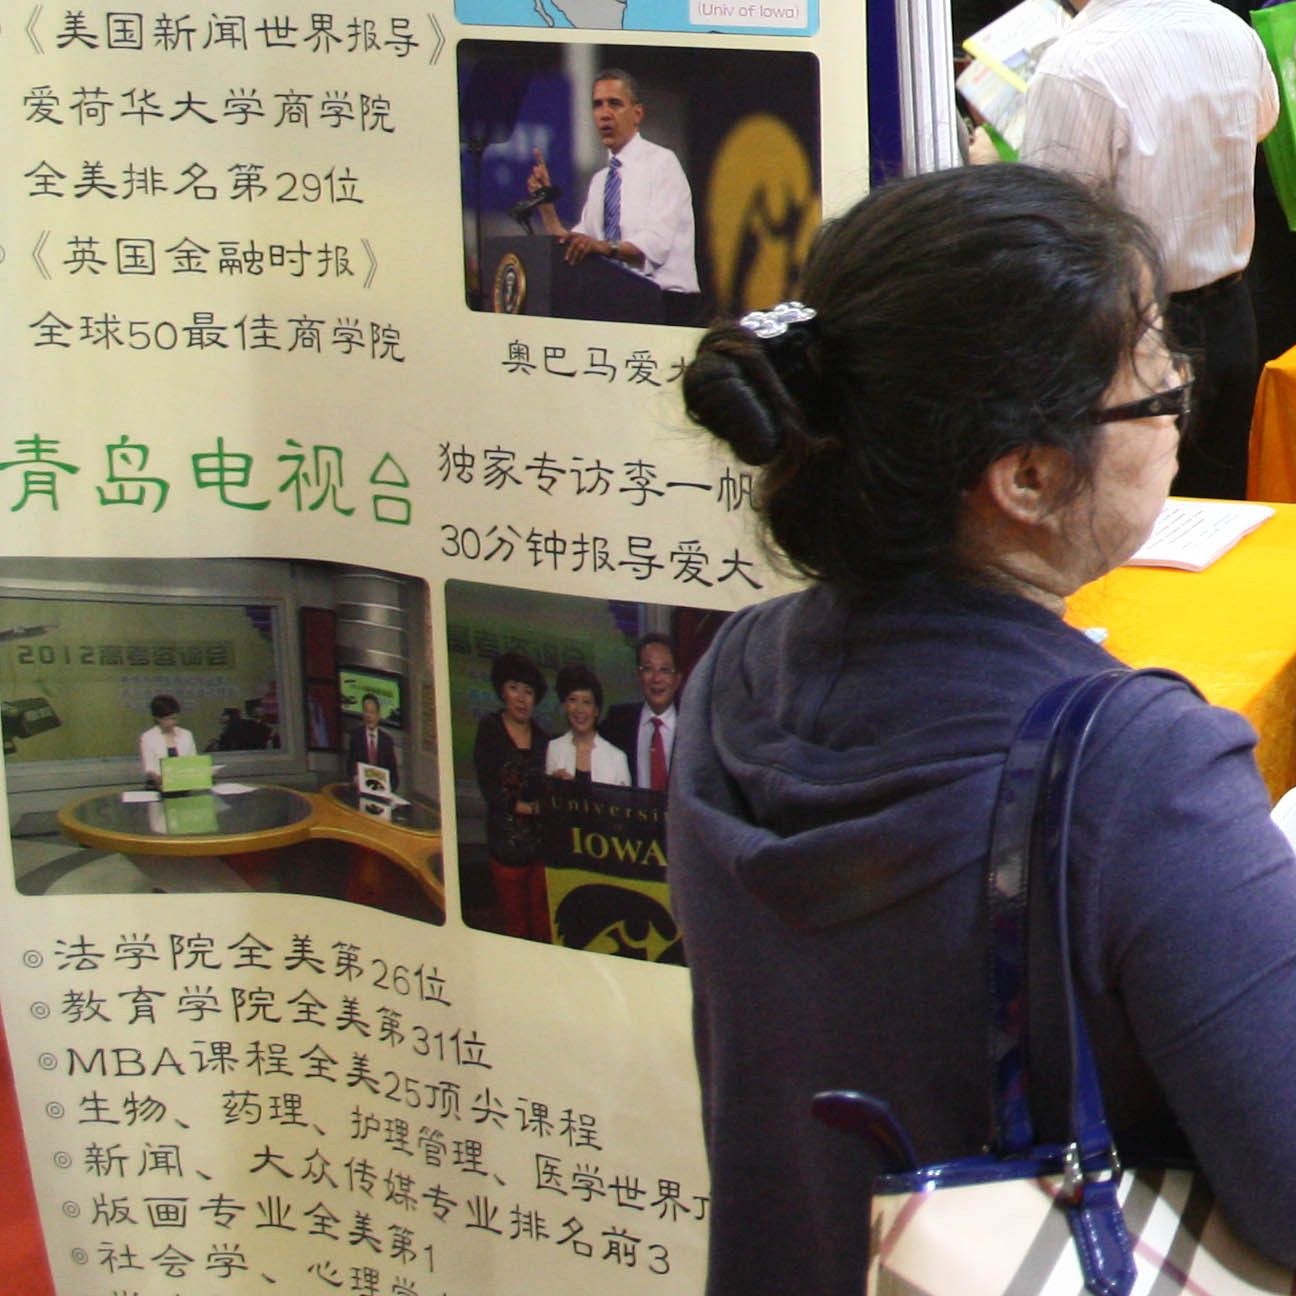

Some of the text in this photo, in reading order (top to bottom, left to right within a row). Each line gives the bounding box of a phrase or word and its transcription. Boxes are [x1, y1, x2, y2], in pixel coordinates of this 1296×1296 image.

[738, 5, 757, 17] of
[22, 84, 398, 136] 爱荷华大学商学院
[22, 158, 366, 208] 全美排名第29位
[27, 309, 408, 366] 全球50最佳商学院
[0, 432, 413, 527] 青岛电视台
[439, 522, 764, 593] 30分钟报导爱大
[54, 931, 454, 1008] 法学院全美第26位
[60, 985, 494, 1071] 教育学院全美第31位
[65, 1039, 604, 1152] MBA课程全美25顶尖课程
[91, 1193, 438, 1273] 版画专业全美第1
